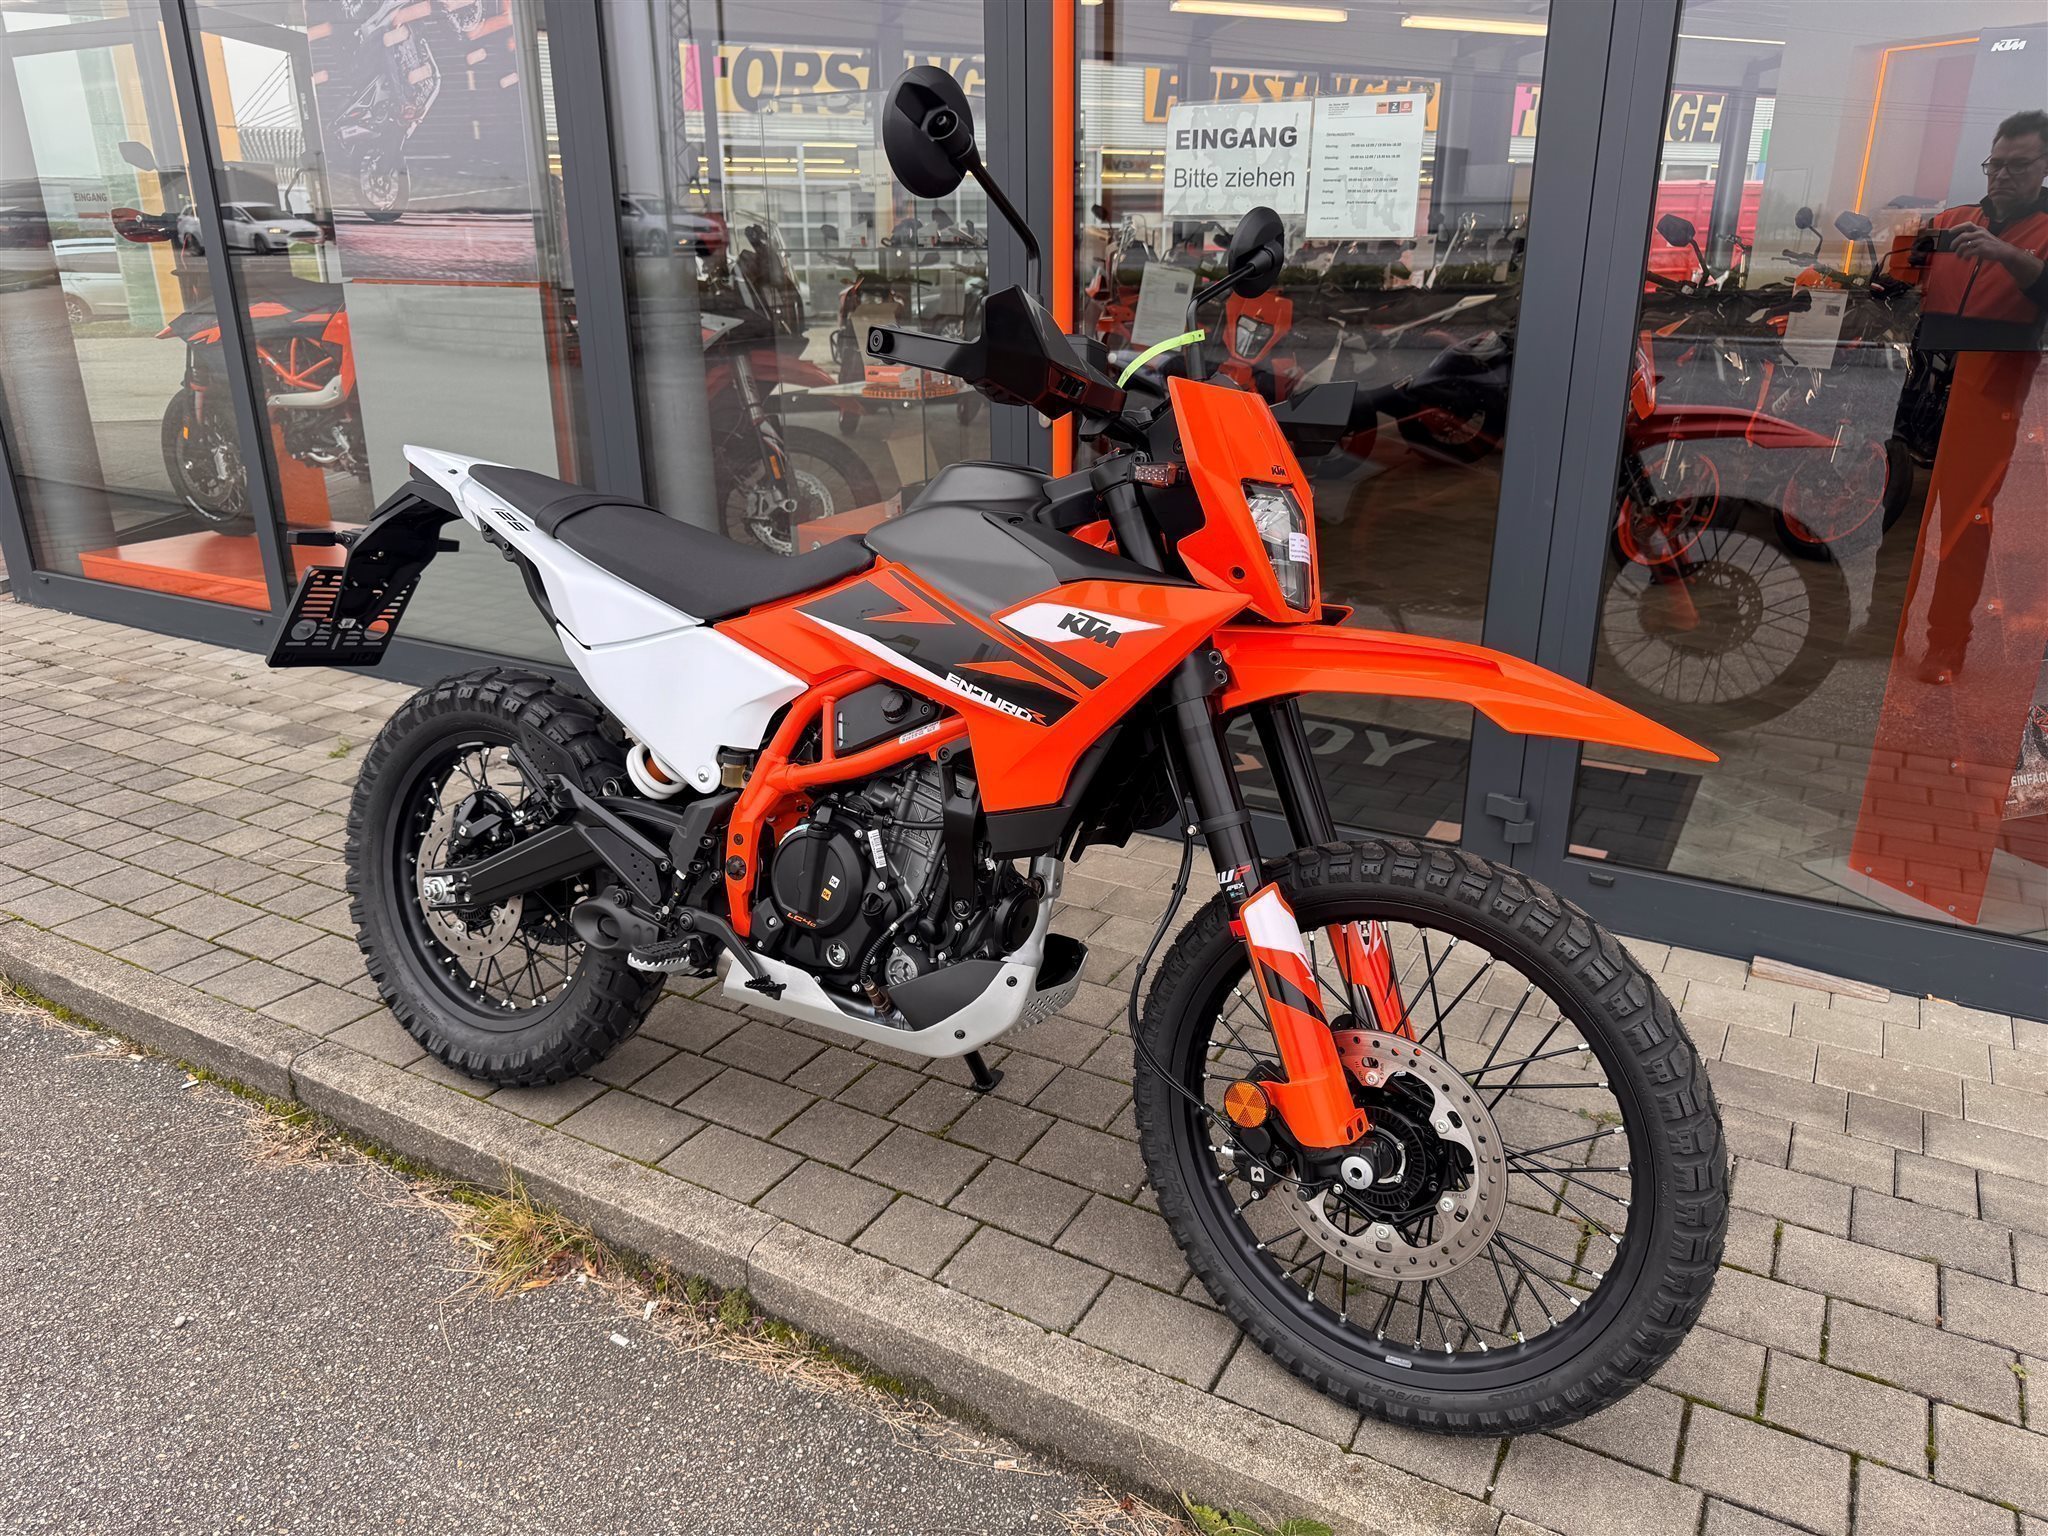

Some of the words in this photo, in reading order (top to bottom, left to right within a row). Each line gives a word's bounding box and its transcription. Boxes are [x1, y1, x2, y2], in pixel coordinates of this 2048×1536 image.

[1990, 38, 2028, 52] KTM
[1175, 126, 1298, 150] EINGANG
[1173, 167, 1218, 188] Bitte
[1225, 166, 1295, 188] ziehen
[73, 192, 108, 202] EINGANG
[1271, 464, 1287, 476] KTM
[1057, 611, 1122, 649] KTM
[945, 672, 1033, 722] ENDURO
[830, 878, 838, 886] OK
[1217, 864, 1252, 885] WP
[822, 890, 830, 898] OK
